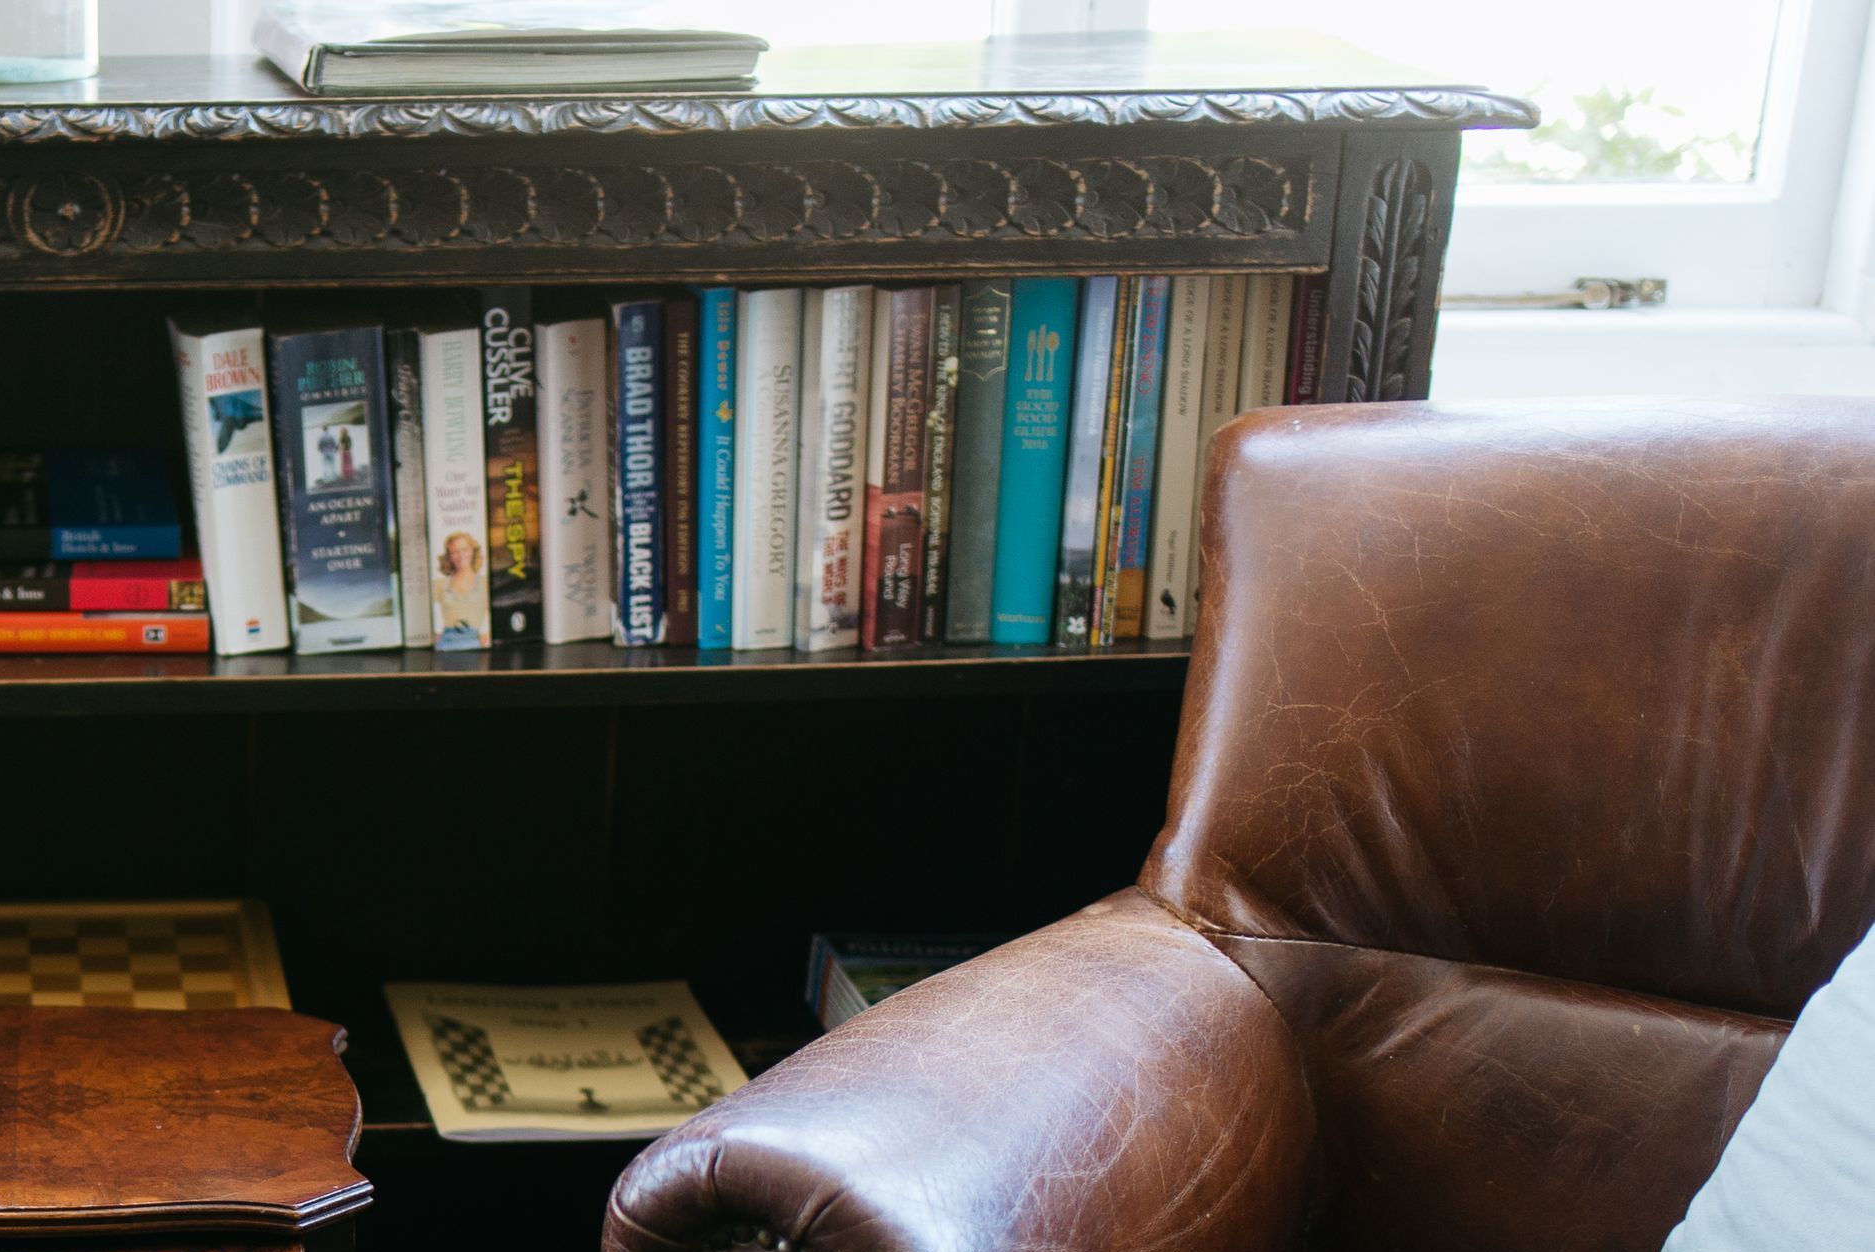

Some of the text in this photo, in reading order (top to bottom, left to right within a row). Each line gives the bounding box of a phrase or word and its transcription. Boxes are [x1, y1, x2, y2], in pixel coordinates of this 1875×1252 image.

[213, 350, 249, 368] DALE
[484, 307, 512, 427] CUSSLER
[509, 328, 533, 400] CLIVE
[1298, 289, 1323, 396] Understanding
[205, 368, 260, 391] BROWN
[624, 346, 653, 415] BRAD
[887, 314, 907, 485] CHARLEY BOORMAN
[1262, 369, 1272, 406] SHADO
[627, 419, 654, 488] THOR
[714, 448, 731, 490] Could
[768, 364, 793, 578] SUSANNA GREGORY
[826, 401, 857, 521] GODDARD
[504, 461, 523, 519] THE
[711, 494, 731, 549] Happen
[505, 523, 526, 581] SPY
[627, 522, 654, 590] BLACK
[715, 554, 730, 571] To
[883, 554, 897, 600] Round
[893, 542, 912, 609] Long Way
[2, 588, 13, 601] &
[629, 595, 654, 638] LIST
[714, 575, 730, 601] You
